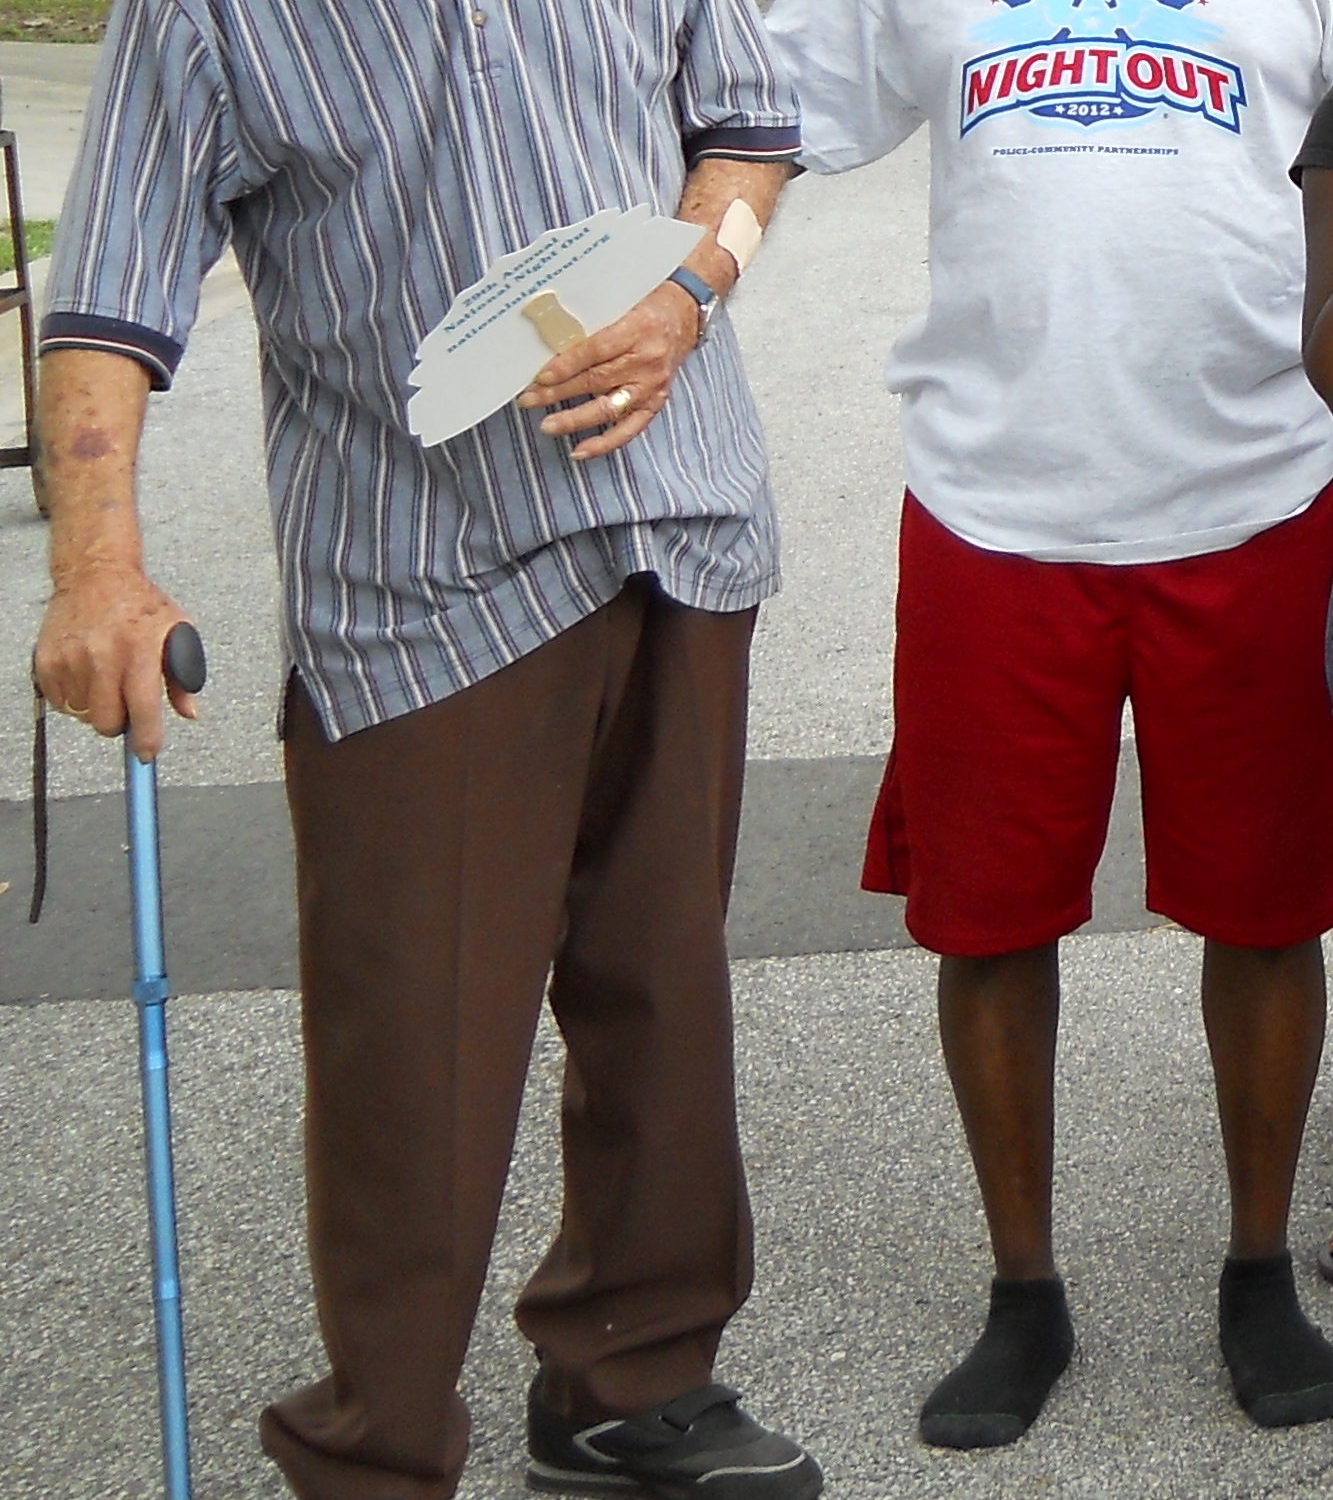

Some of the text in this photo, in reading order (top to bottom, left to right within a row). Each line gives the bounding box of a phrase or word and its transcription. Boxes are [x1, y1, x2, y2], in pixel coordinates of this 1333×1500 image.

[966, 49, 1230, 116] NIGHT OUT
[1066, 103, 1112, 117] 2012
[1096, 145, 1180, 157] PARTNERSHIPS
[443, 226, 591, 334] National Night Out
[502, 236, 560, 280] Annual
[446, 233, 612, 353] nationalnightout.org
